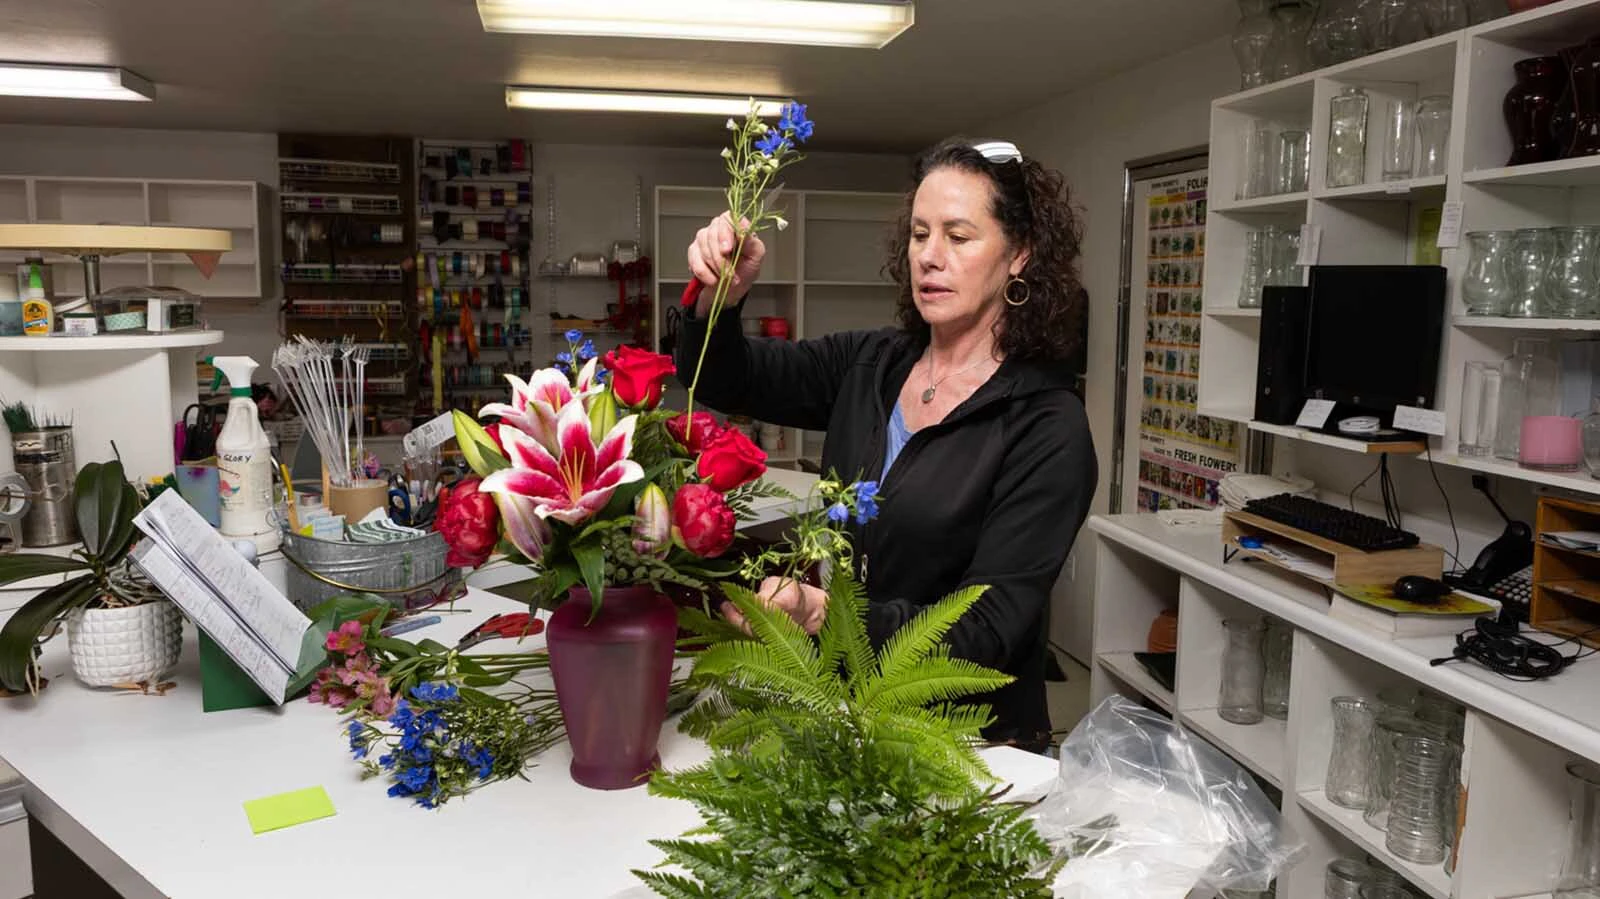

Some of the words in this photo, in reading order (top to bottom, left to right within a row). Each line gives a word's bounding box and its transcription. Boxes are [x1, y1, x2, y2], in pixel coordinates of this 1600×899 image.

[223, 454, 251, 463] GLORY
[1175, 448, 1197, 463] FRESH
[1199, 455, 1237, 472] FLOWERS
